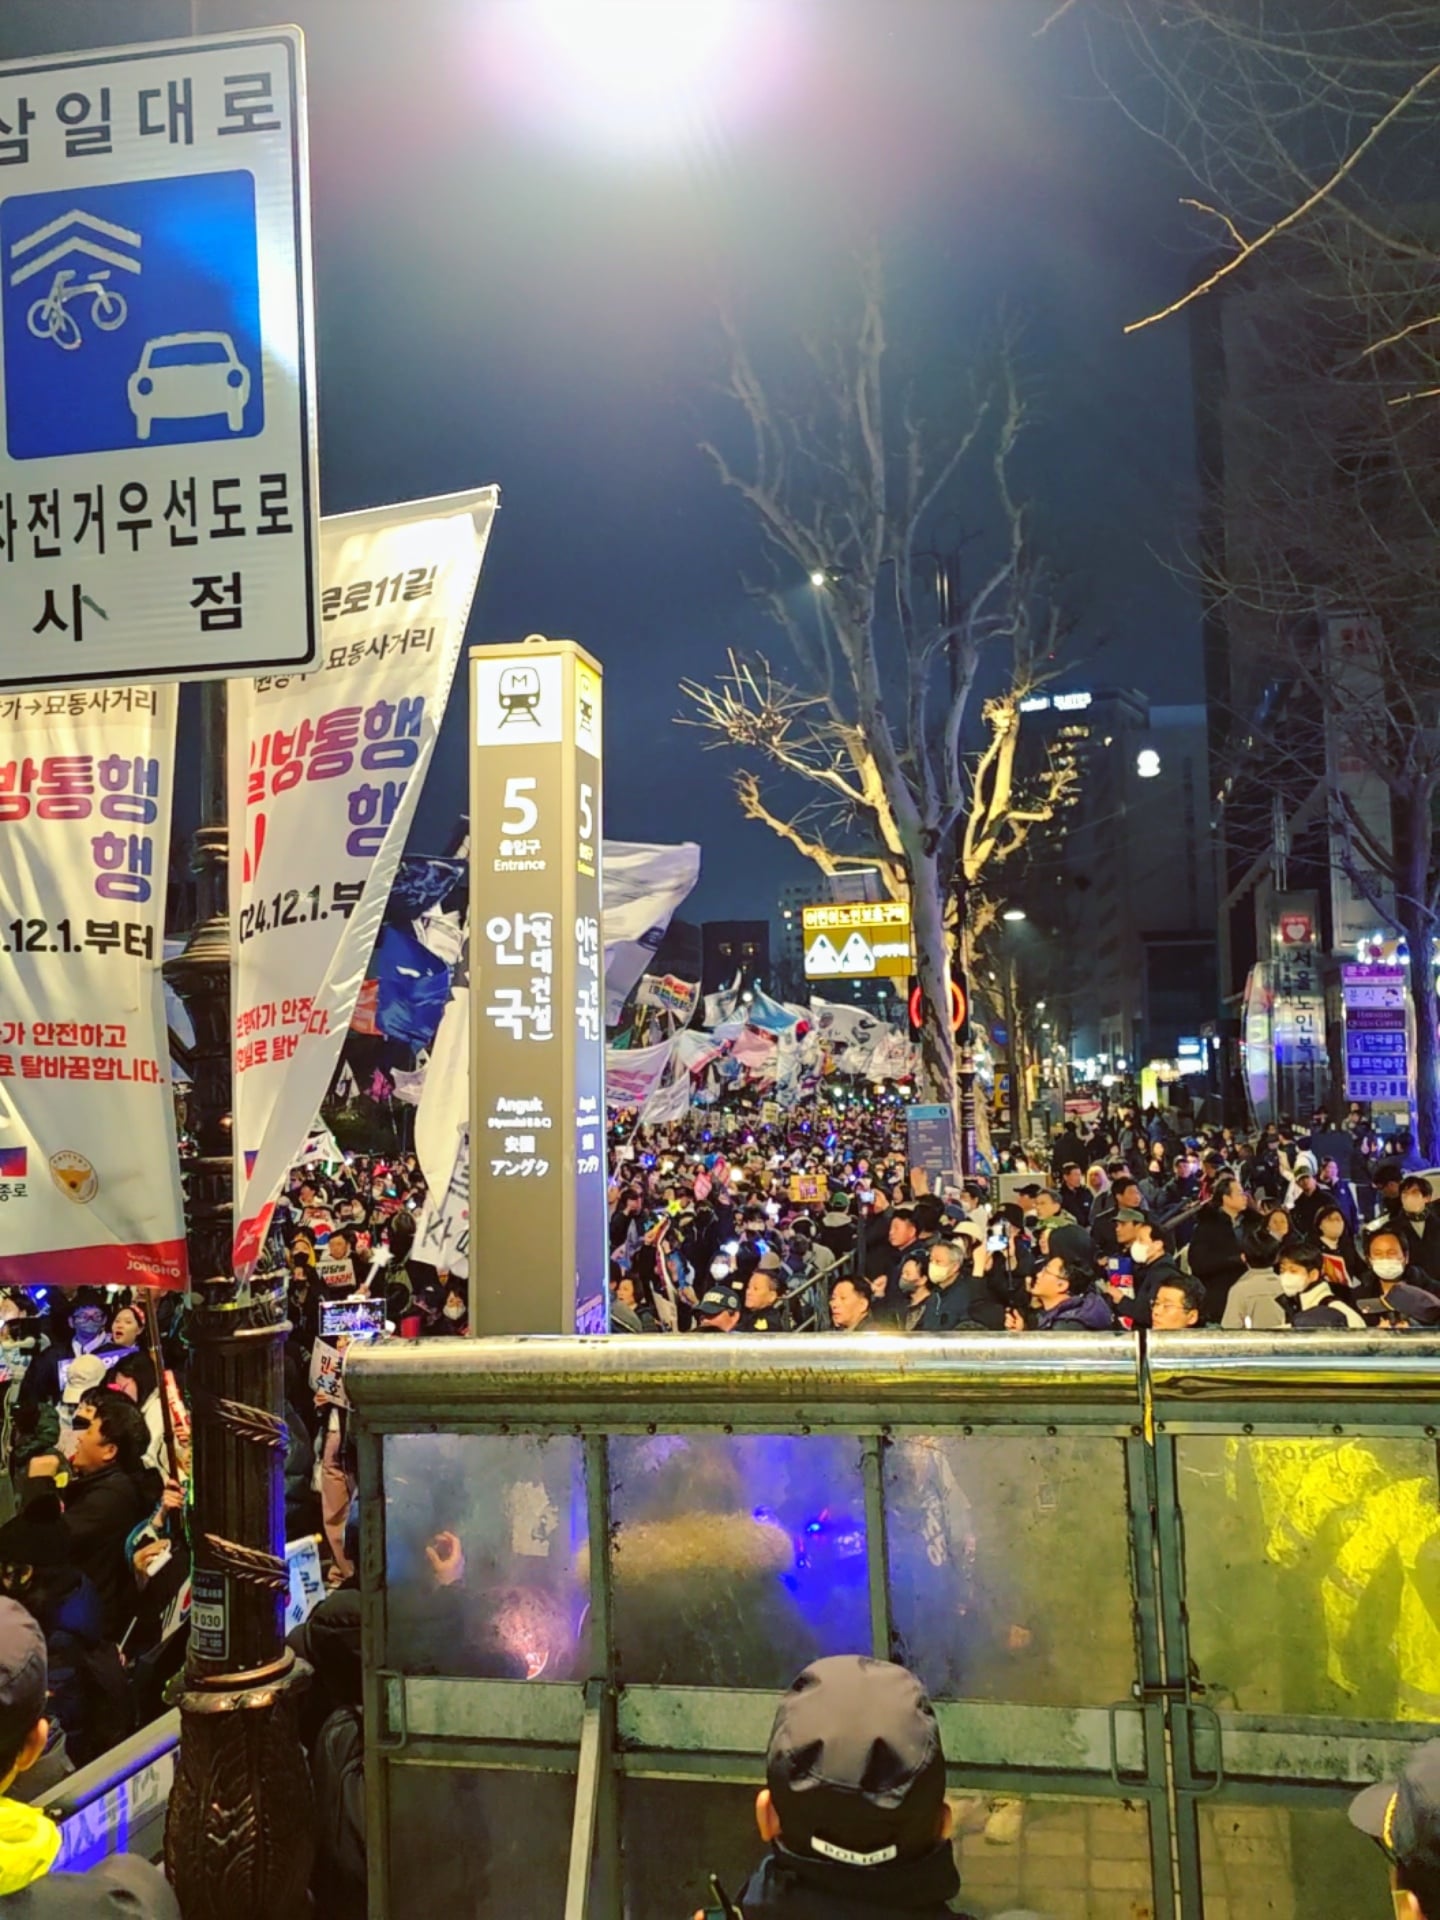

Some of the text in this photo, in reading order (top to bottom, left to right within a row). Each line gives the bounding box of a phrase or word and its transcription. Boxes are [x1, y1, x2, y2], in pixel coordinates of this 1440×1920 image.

[325, 626, 436, 671] 묘동사거리
[501, 777, 538, 835] 5
[579, 783, 592, 840] 5
[90, 831, 153, 903] 행
[494, 859, 546, 872] Entrance
[486, 912, 532, 1040] 안국
[32, 1022, 127, 1048] 안전하고
[21, 1055, 165, 1084] 탈바꿈합니다.
[496, 1096, 544, 1115] Anguk
[490, 1158, 549, 1178] アングク
